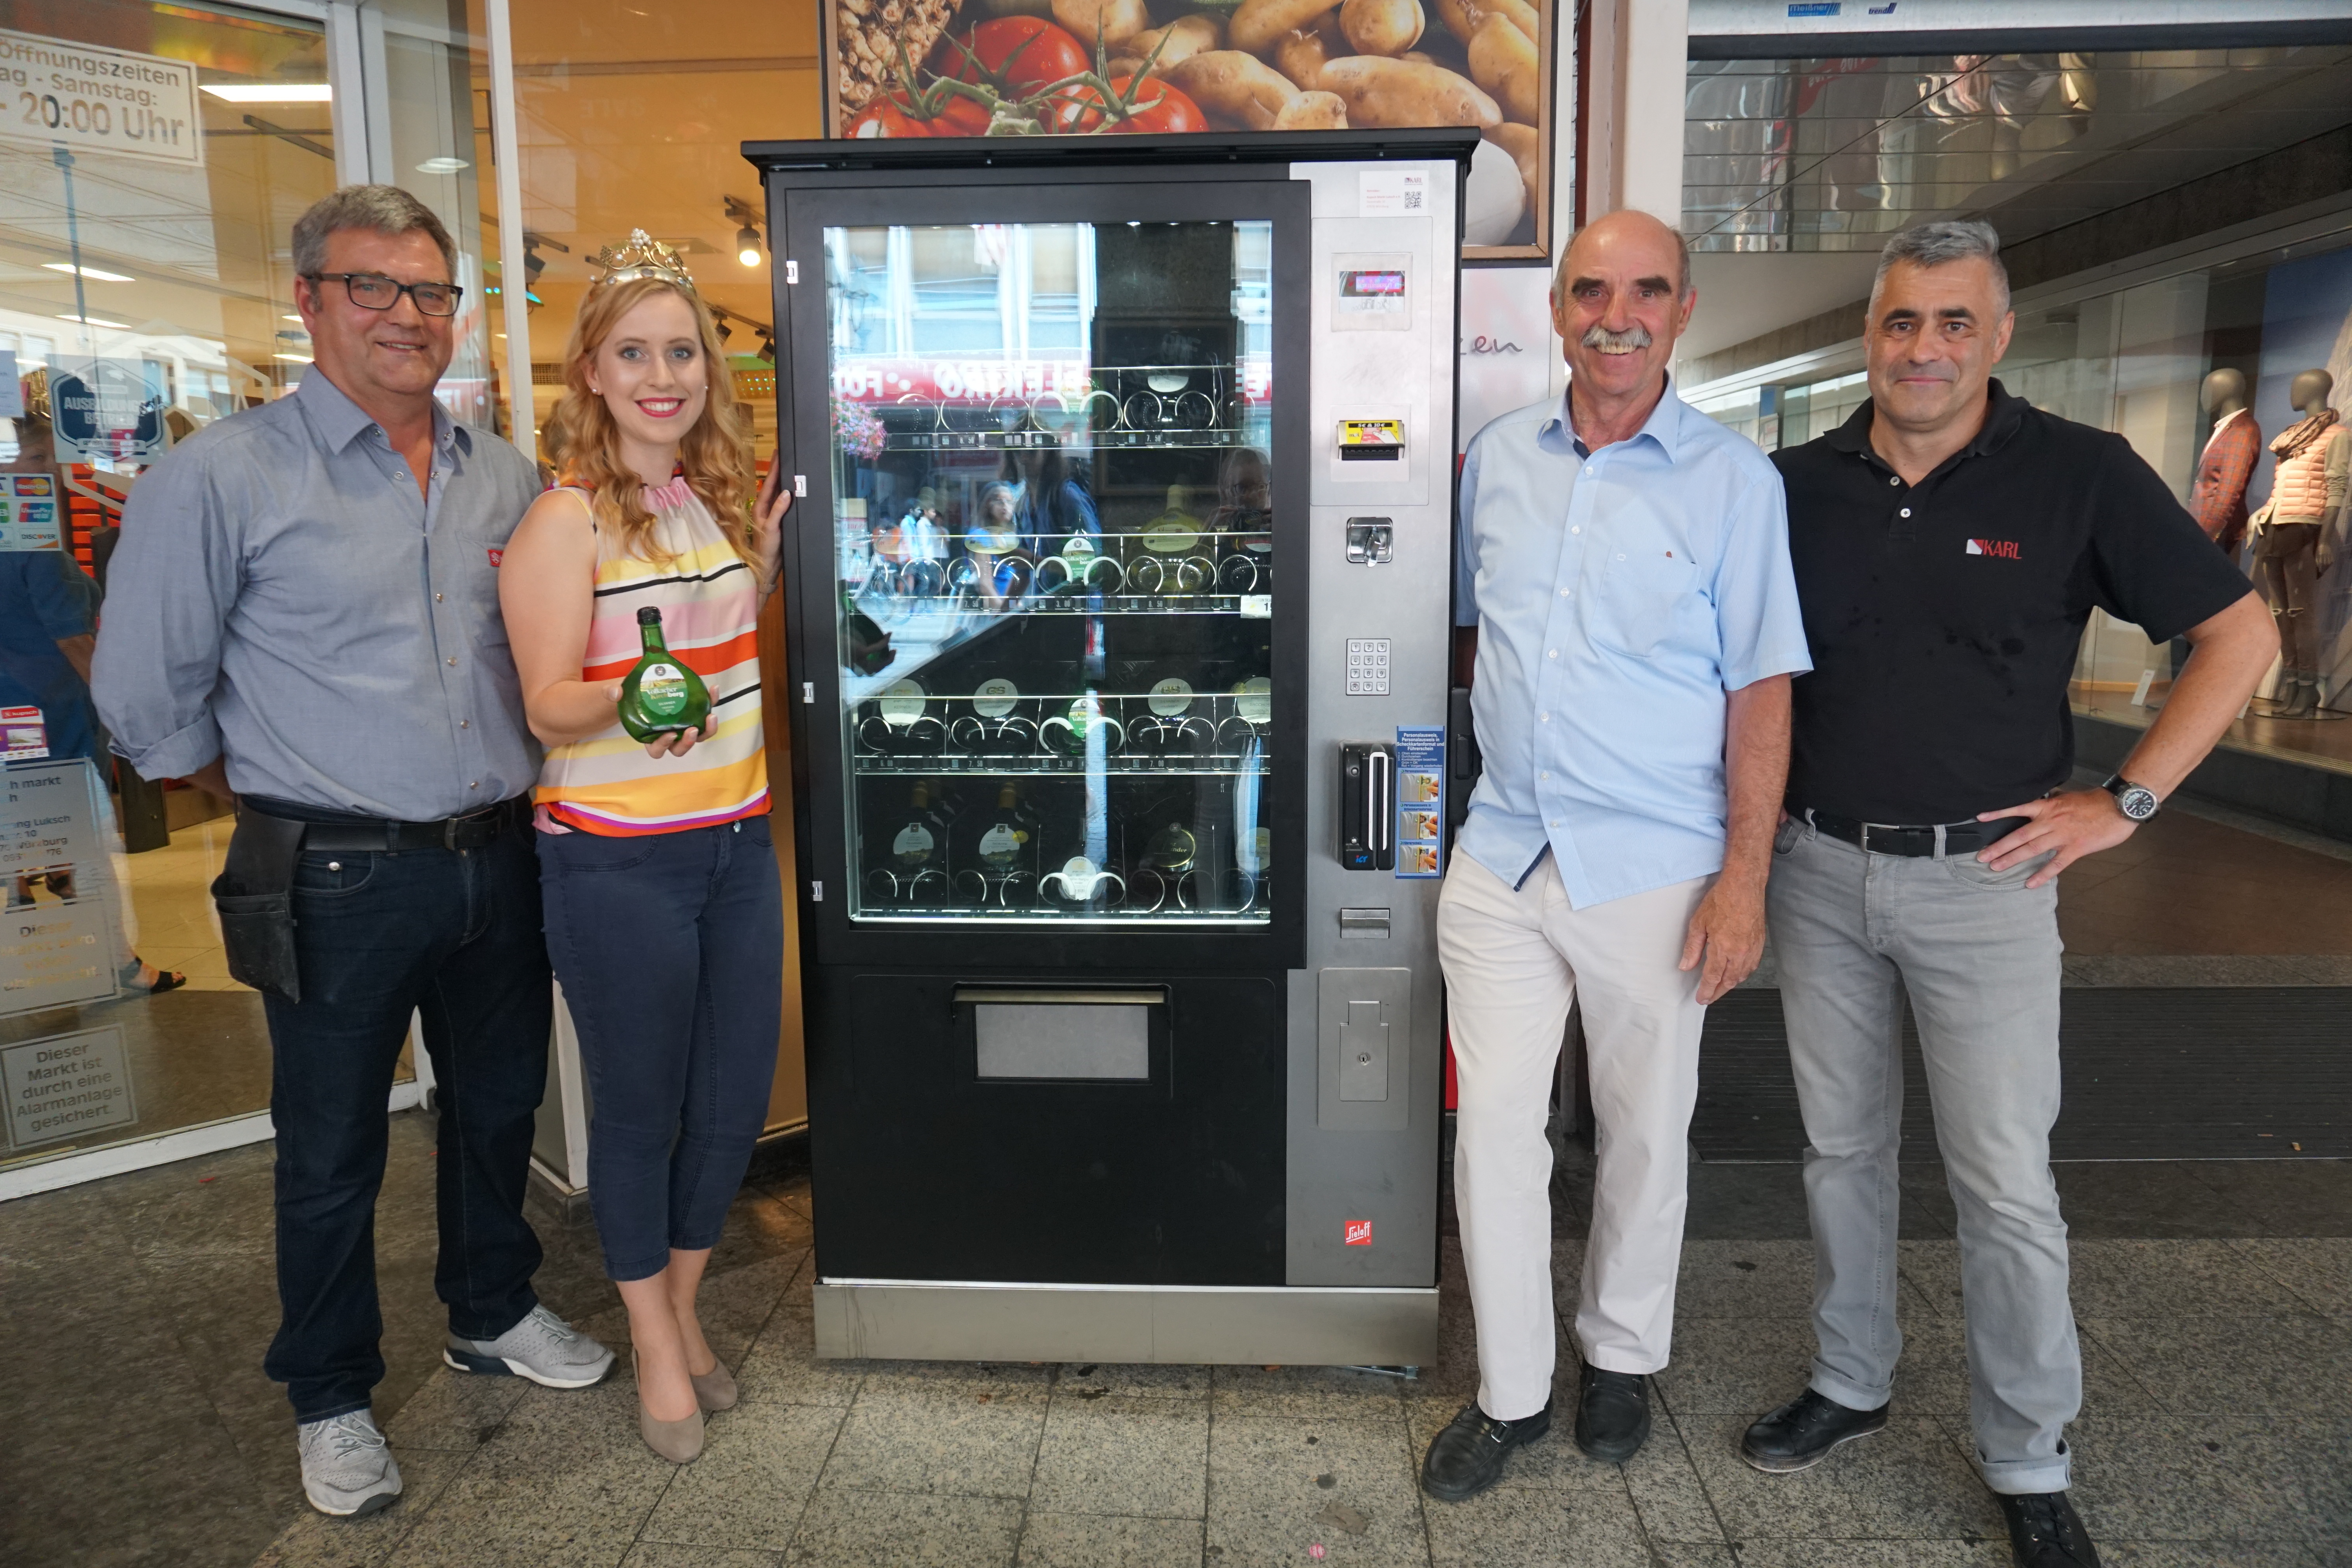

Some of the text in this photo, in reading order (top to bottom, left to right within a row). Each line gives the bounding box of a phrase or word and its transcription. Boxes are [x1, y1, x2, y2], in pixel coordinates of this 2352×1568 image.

[0, 40, 180, 87] Öffnungszeiten
[51, 73, 158, 107] Samstag:
[19, 91, 111, 135] 20:00
[122, 107, 184, 146] Uhr
[1983, 539, 2022, 559] KARL
[647, 687, 677, 695] Volkacher
[22, 776, 62, 788] markt
[34, 815, 71, 826] Luksch
[24, 829, 37, 838] 10
[36, 1044, 89, 1063] Dieser
[27, 1056, 102, 1082] Markt ist
[22, 1072, 112, 1099] durch eine
[17, 1086, 123, 1117] Alarmanlage
[31, 1104, 114, 1132] gesichert.
[1345, 1221, 1370, 1241] Sielaff
